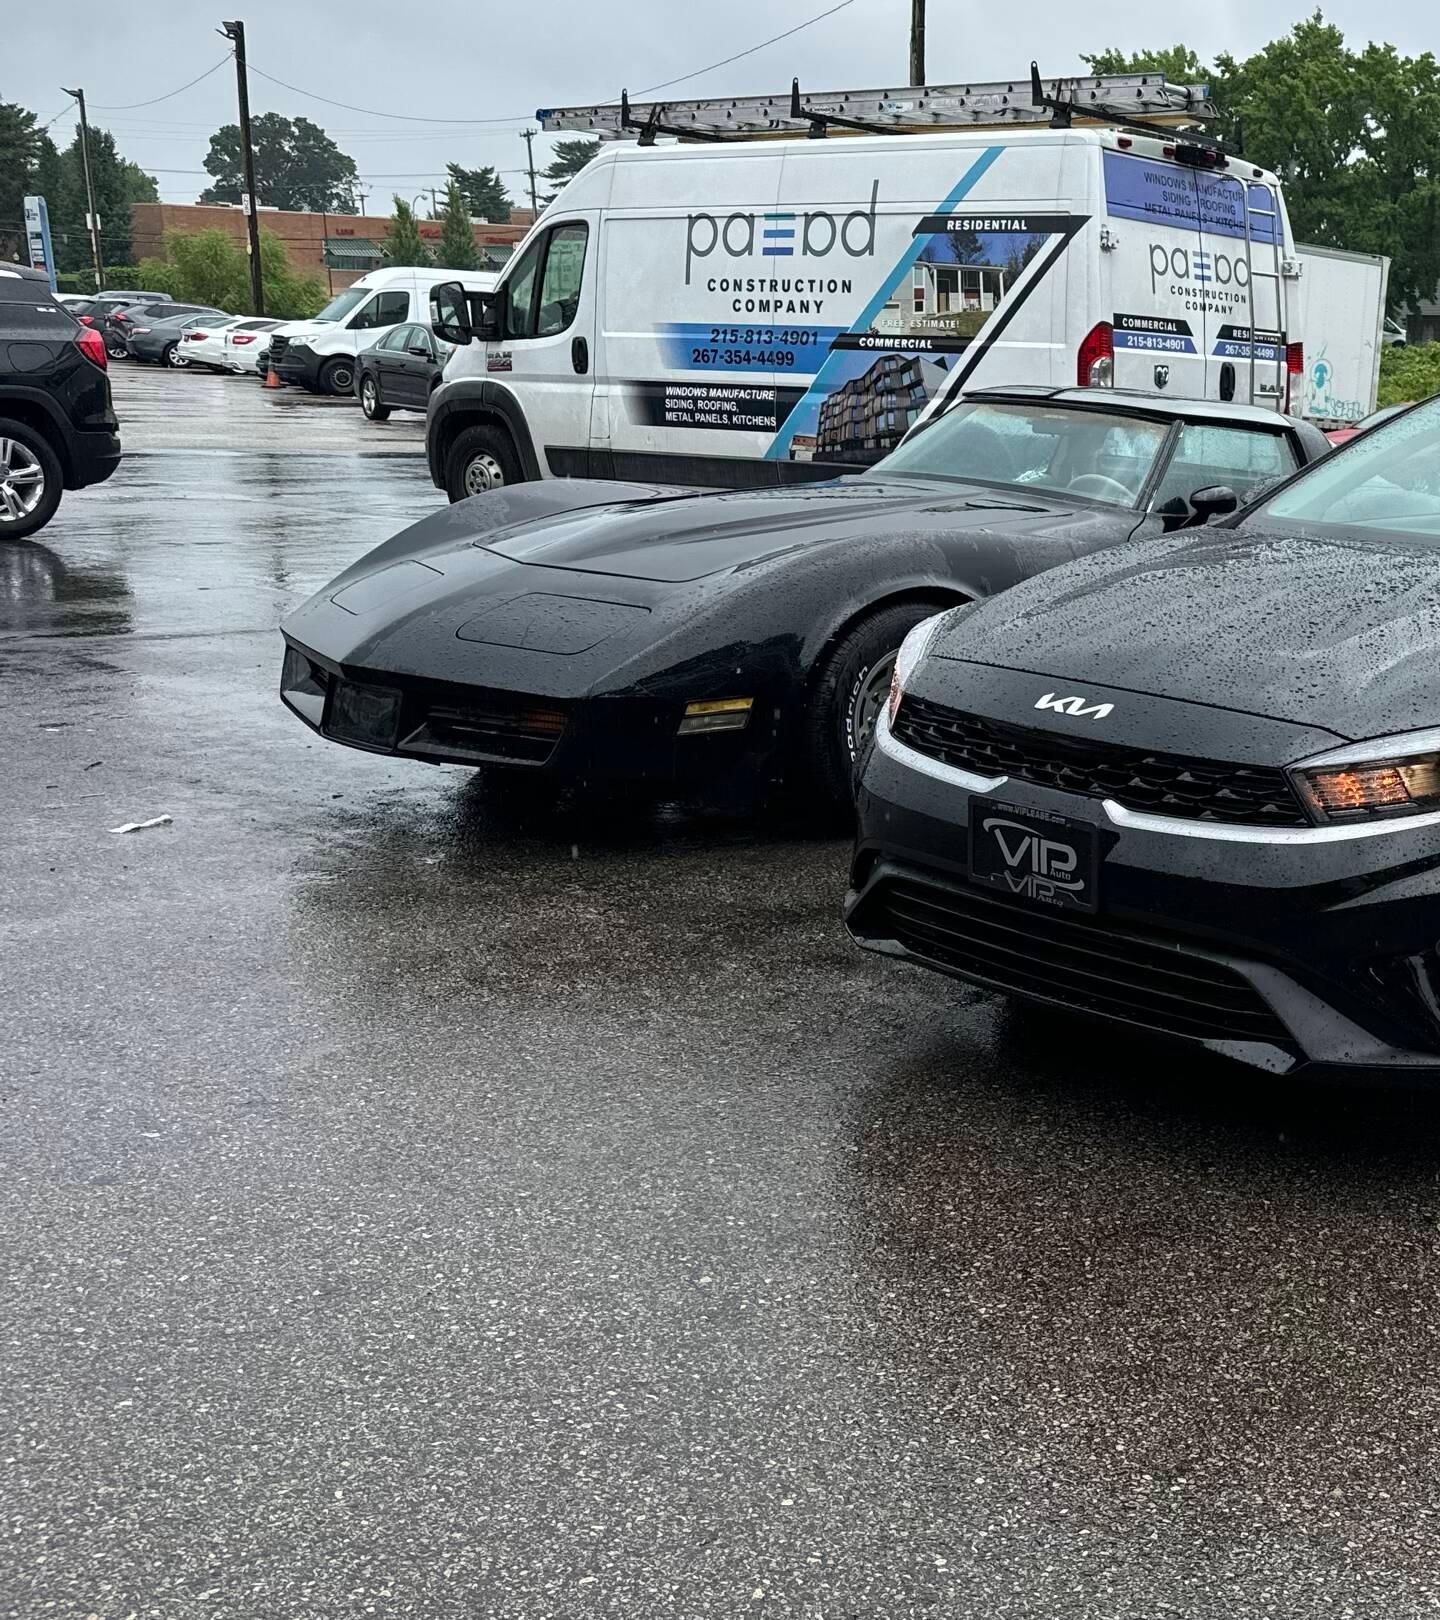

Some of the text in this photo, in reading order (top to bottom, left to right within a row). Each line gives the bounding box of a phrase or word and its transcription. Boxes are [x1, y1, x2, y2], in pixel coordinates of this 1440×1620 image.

[1143, 171, 1245, 202] WINDOWS MANUFACTUR
[1162, 190, 1236, 216] SIDING ROOFING
[946, 219, 1028, 231] RESIDENTIAL
[1144, 202, 1173, 217] METAL
[1215, 215, 1254, 233] KITCHES
[707, 278, 852, 293] CONSTRUCTION
[1170, 285, 1247, 304] CONSTRUCTION
[732, 299, 824, 314] COMPANY
[1185, 300, 1233, 315] COMPANY
[881, 319, 960, 329] FREE ESTIMATE!
[1122, 317, 1177, 332] COMMERCIAL
[709, 328, 819, 346] 215-813-4901
[859, 337, 933, 349] COMMERCIAL
[1127, 335, 1185, 351] 215-813-4901
[692, 348, 795, 366] 267-354-4499
[1225, 344, 1275, 359] 267-35-4499
[665, 386, 775, 400] WINDOWS MANUFACTURE
[665, 398, 739, 413] SIDING, ROOFING,
[665, 411, 777, 427] METAL PANELS, KITCHENS
[997, 803, 1066, 825] www.VIPLEASE.com
[994, 828, 1078, 875] VIP
[1050, 867, 1071, 881] Auto
[1004, 869, 1055, 899] VIP
[1037, 894, 1064, 907] Auto
